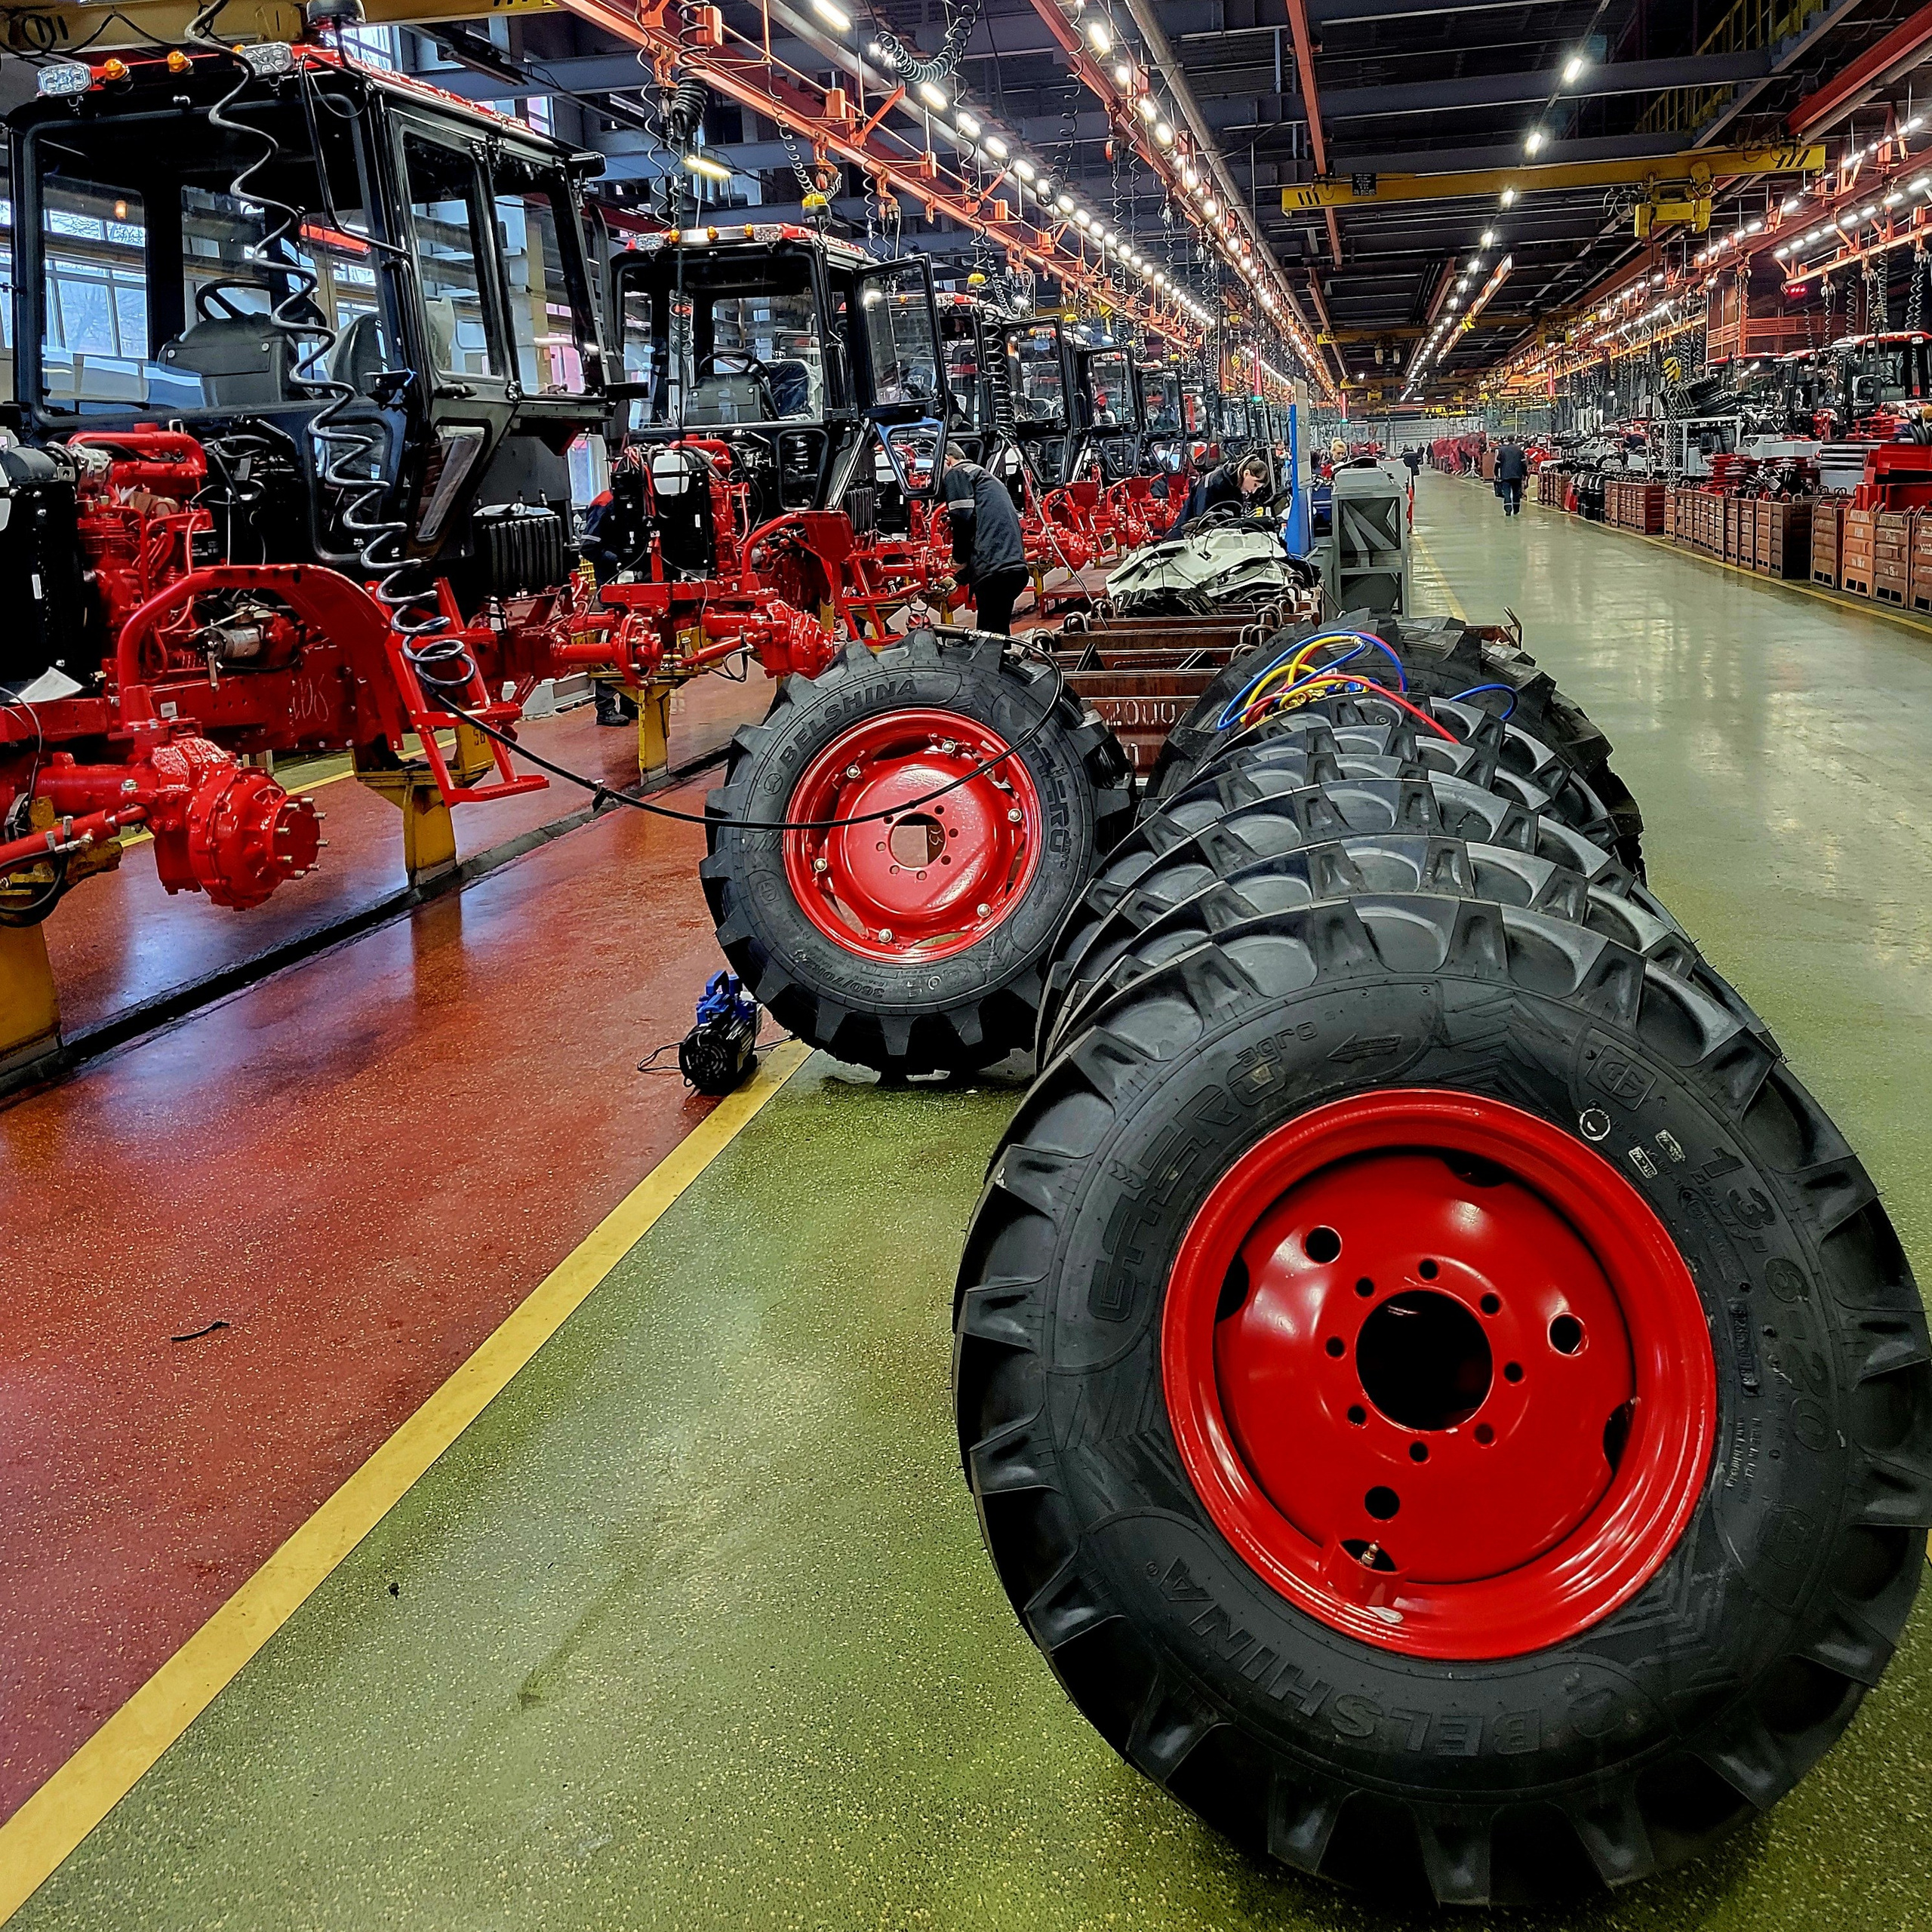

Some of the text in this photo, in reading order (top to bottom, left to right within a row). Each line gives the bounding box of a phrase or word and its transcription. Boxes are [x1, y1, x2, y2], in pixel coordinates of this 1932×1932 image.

[778, 678, 918, 769] BELSHINA
[1235, 1021, 1318, 1066] agro
[1157, 1555, 1541, 1757] BELSHINA
